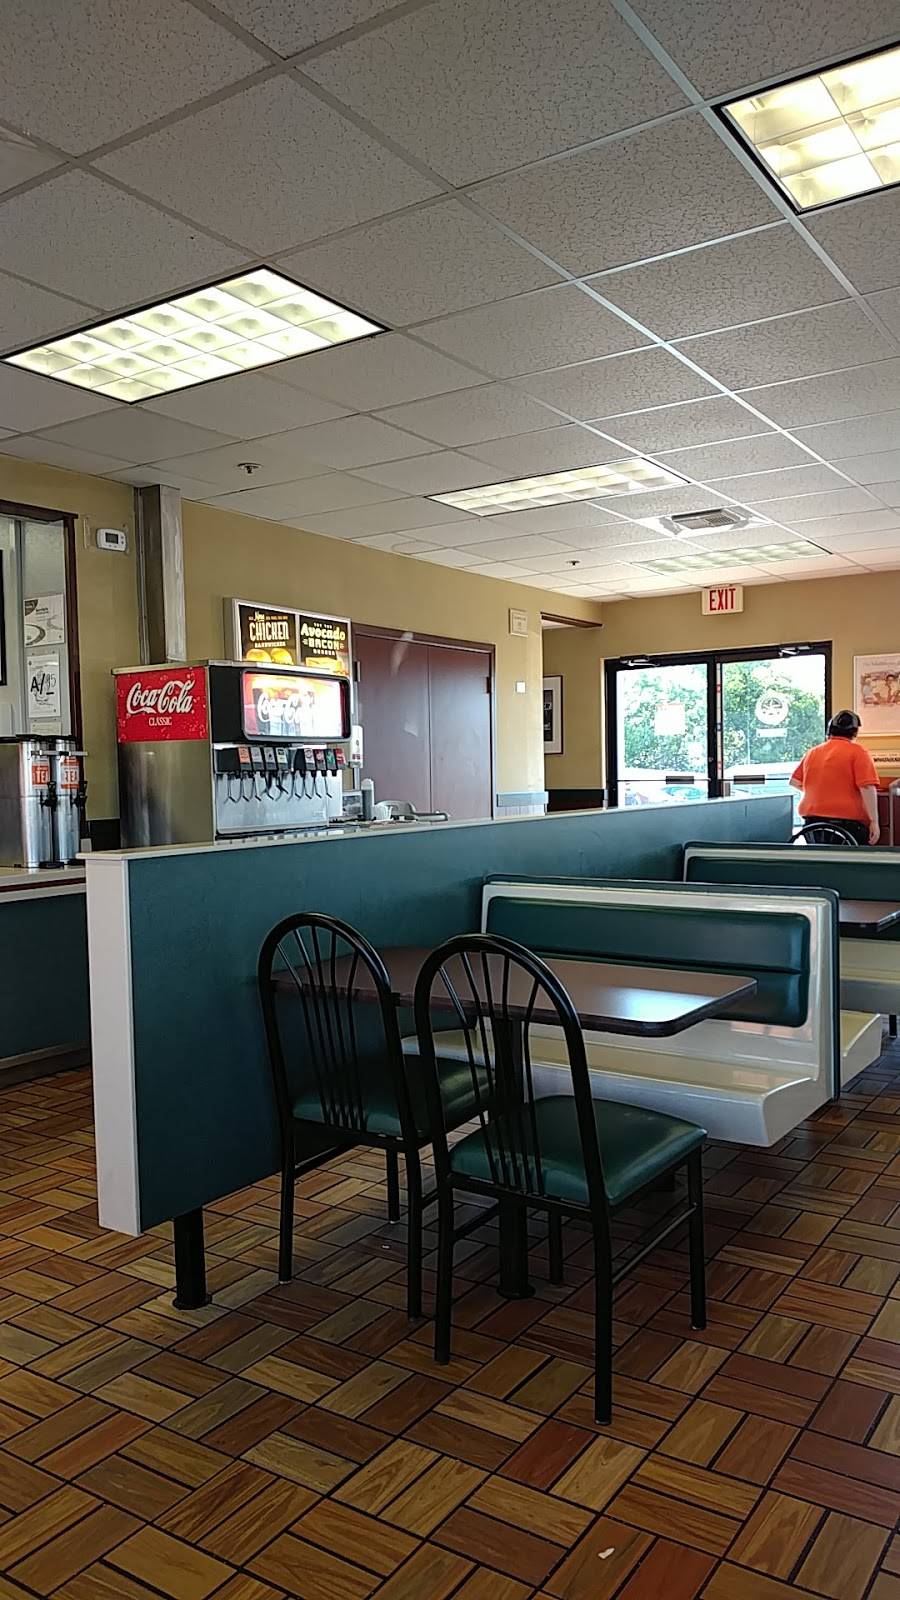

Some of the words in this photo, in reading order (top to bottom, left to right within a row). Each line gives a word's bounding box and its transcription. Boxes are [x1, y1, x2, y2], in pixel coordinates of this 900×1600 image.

[709, 588, 736, 611] EXIT
[249, 621, 289, 641] CHICKEN
[300, 622, 346, 641] Avocado
[308, 637, 340, 651] BACON
[126, 679, 196, 714] Coca-Cola
[148, 716, 173, 727] CLASSIC
